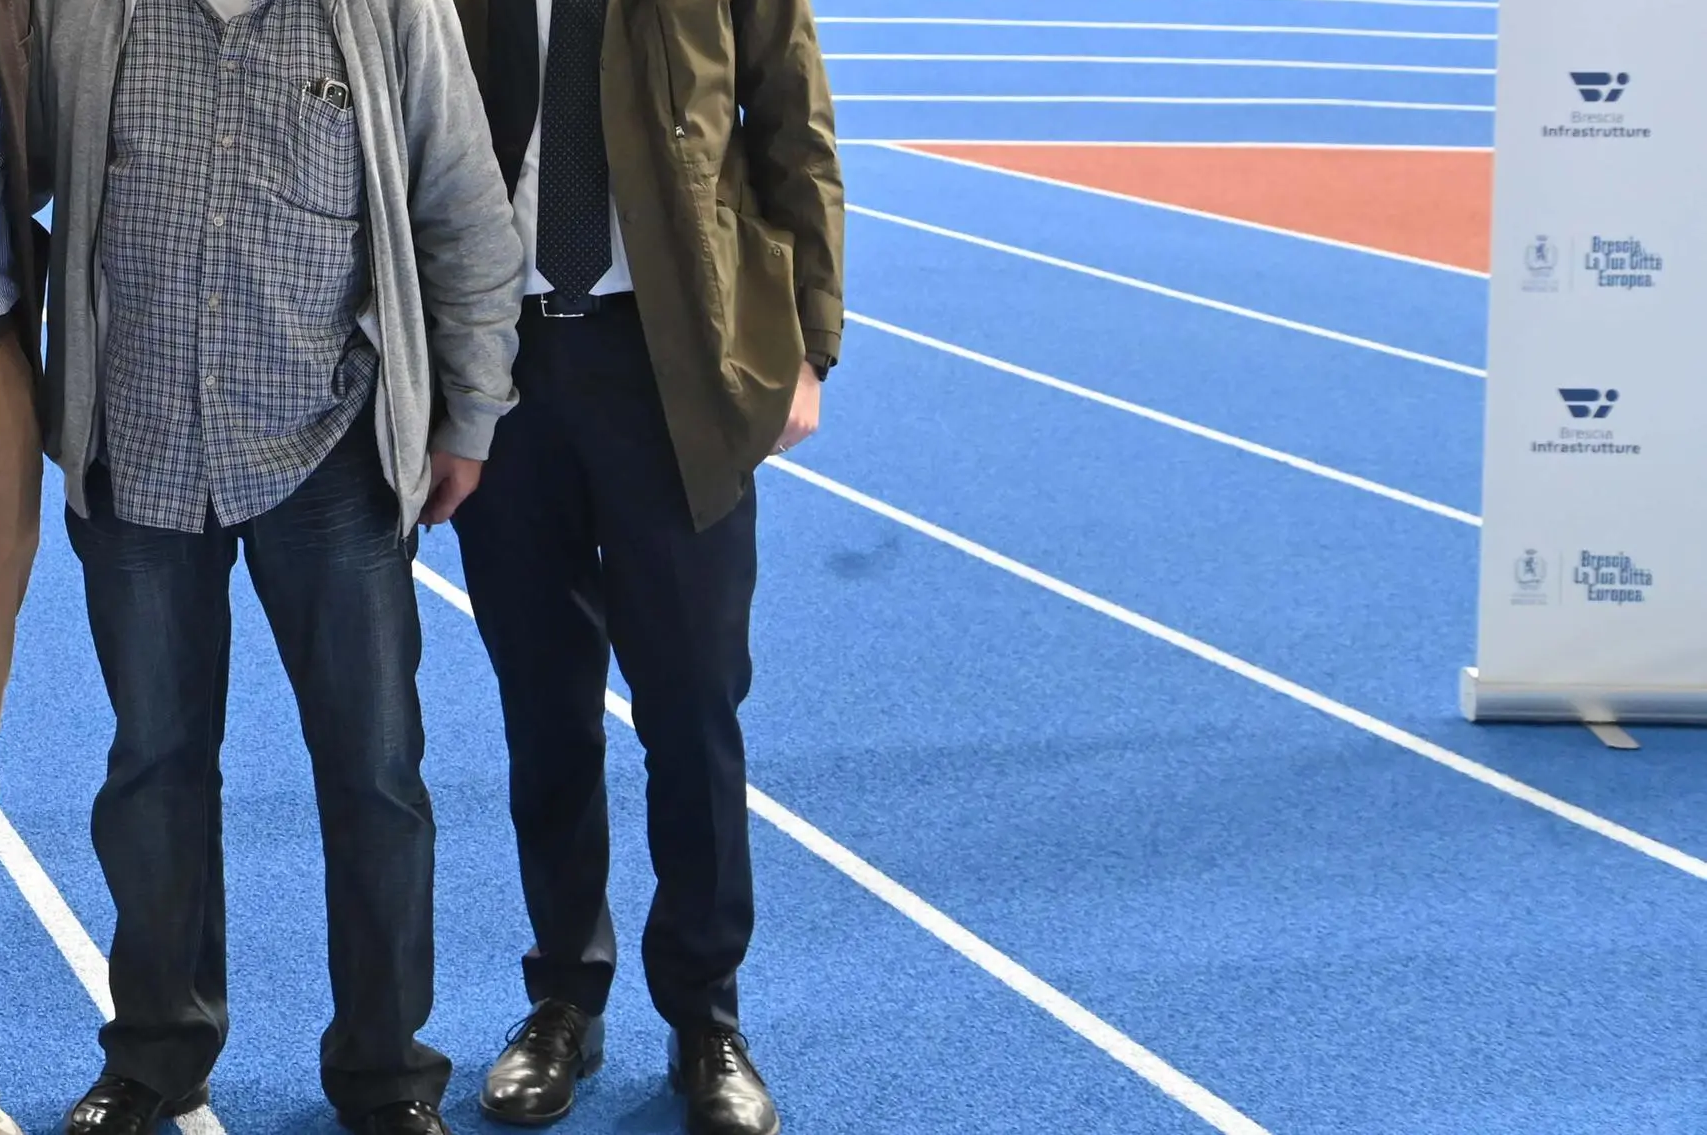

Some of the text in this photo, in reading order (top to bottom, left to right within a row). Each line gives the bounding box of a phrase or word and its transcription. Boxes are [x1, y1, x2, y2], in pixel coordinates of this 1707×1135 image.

[1571, 111, 1624, 123] Brescia
[1542, 126, 1651, 138] Infrastrutture
[1559, 427, 1613, 439] Brescia
[1530, 441, 1641, 454] Infrastrutture
